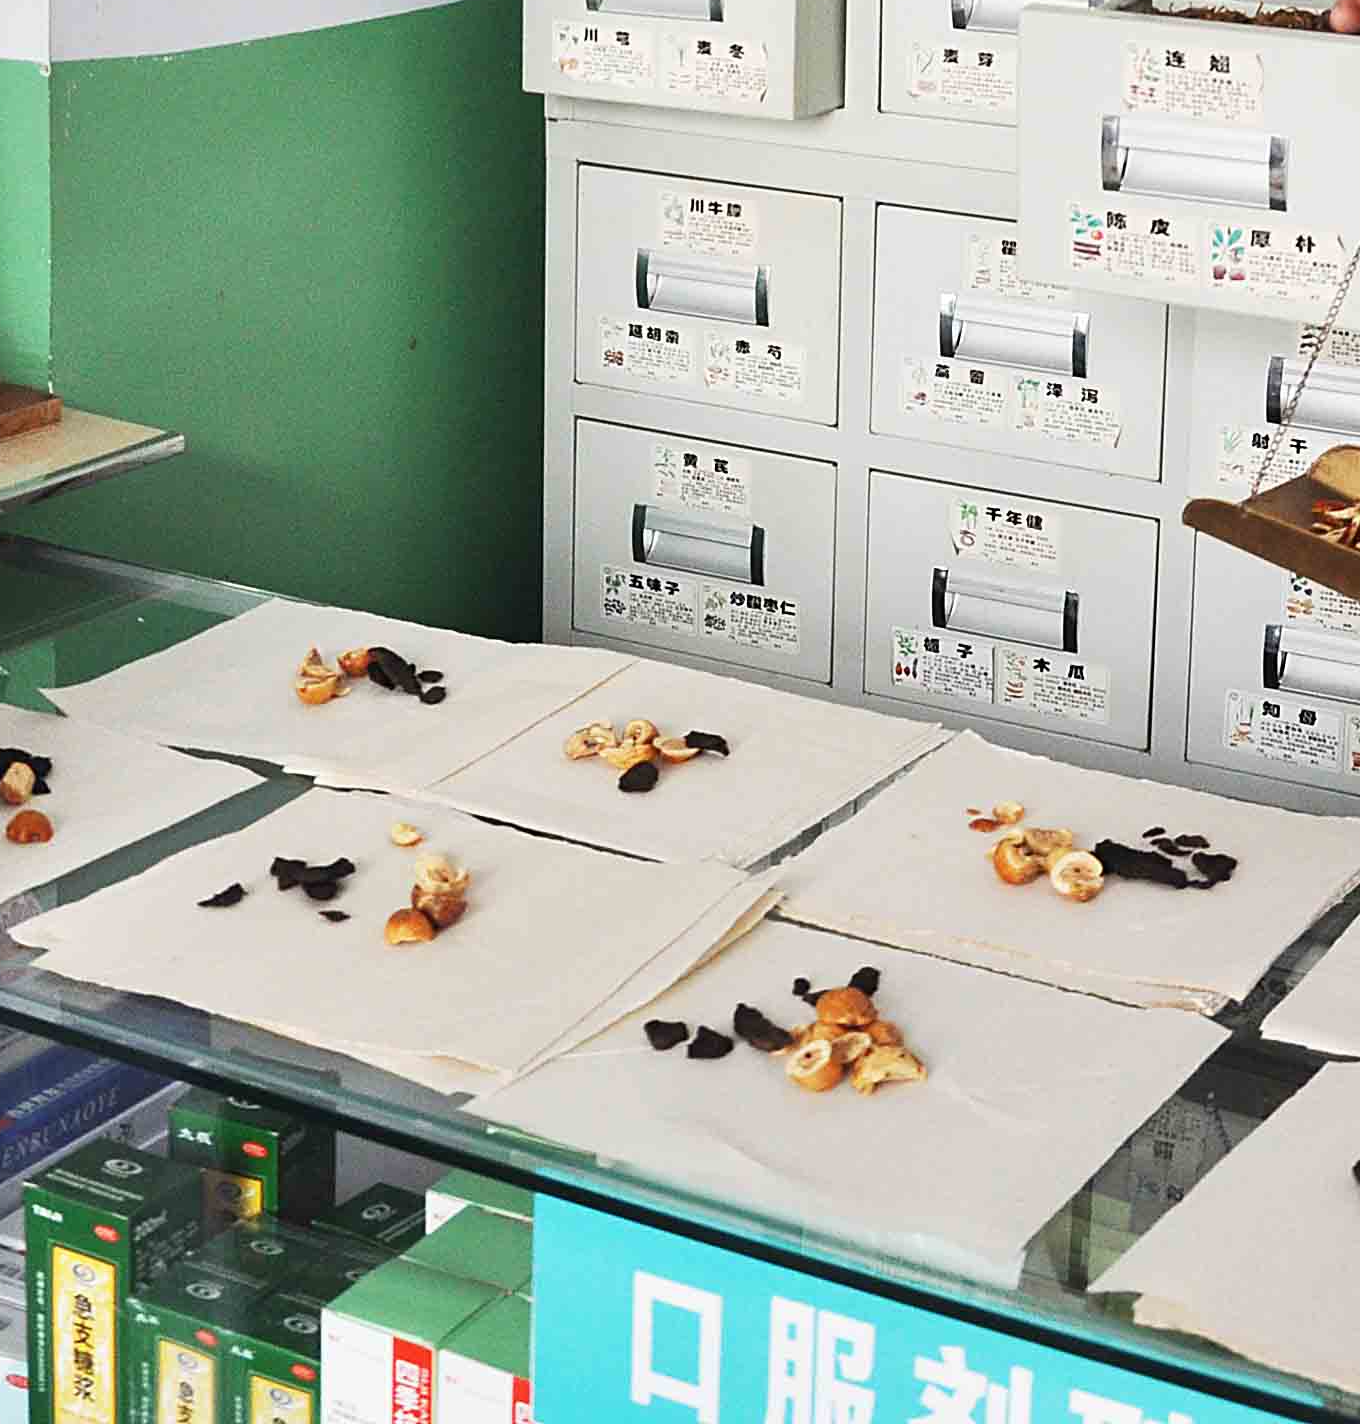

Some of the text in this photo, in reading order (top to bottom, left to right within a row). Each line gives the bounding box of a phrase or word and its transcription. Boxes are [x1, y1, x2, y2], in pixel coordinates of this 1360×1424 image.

[584, 28, 630, 46] 川芎
[1165, 49, 1231, 74] 连翘
[690, 198, 742, 217] 川牛膝
[1106, 211, 1171, 236] 陈皮
[1250, 230, 1316, 254] 厚朴
[628, 323, 680, 344] 延胡索
[735, 340, 783, 360] 赤芍
[1045, 382, 1099, 404] 泽泻
[1251, 433, 1308, 455] 射干
[683, 453, 730, 474] 黄芪
[985, 506, 1044, 531] 千年健
[628, 574, 680, 596] 五味子
[729, 591, 797, 617] 炒酸枣仁
[1032, 657, 1085, 681] 木瓜
[1261, 701, 1318, 726] 知母
